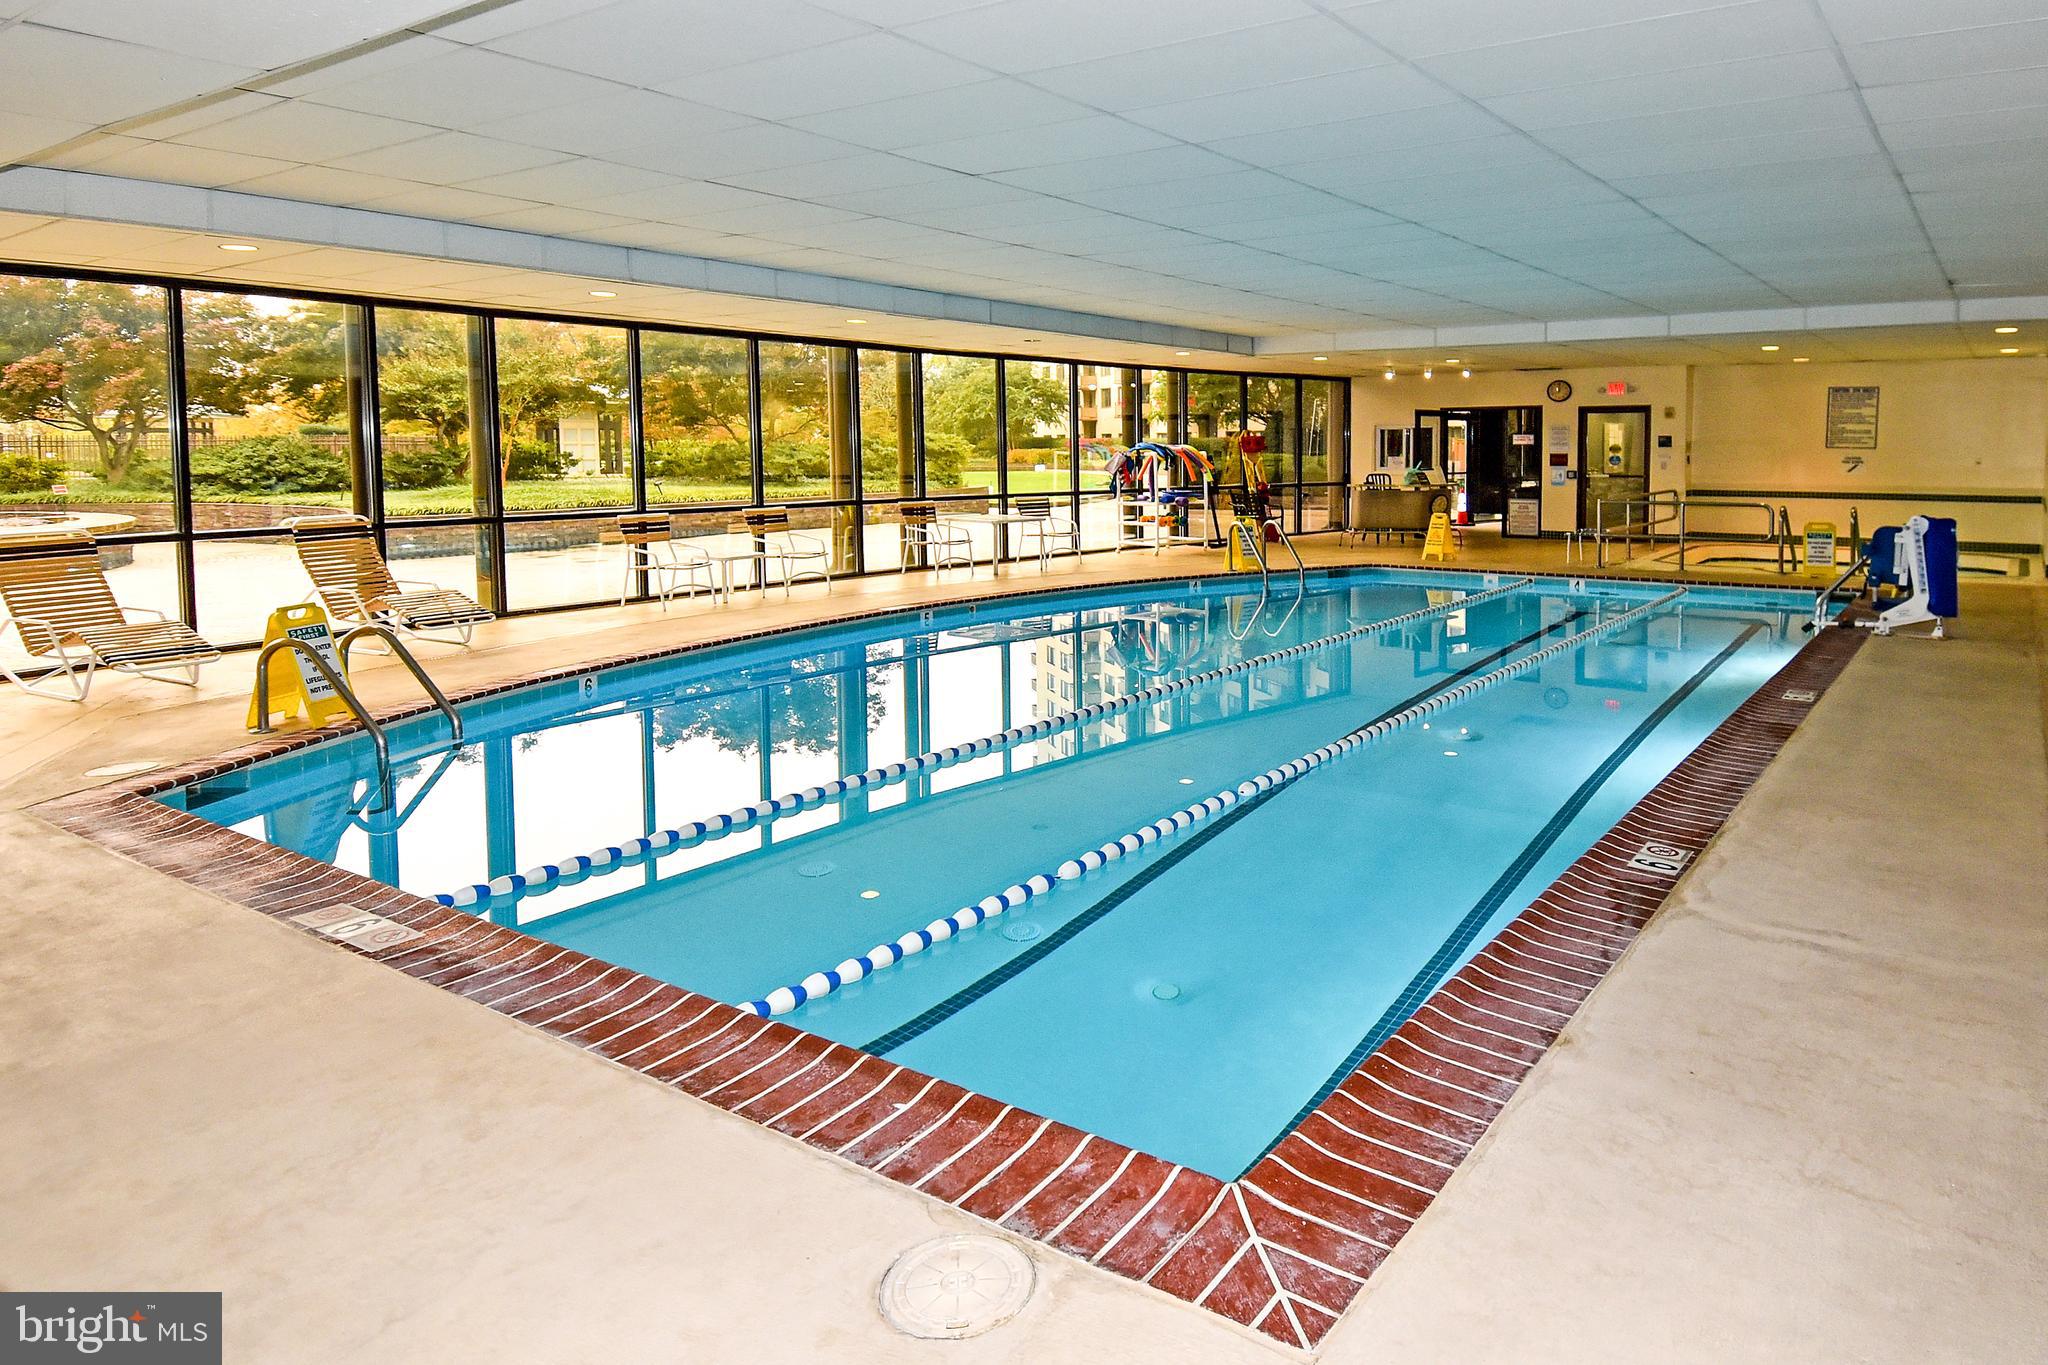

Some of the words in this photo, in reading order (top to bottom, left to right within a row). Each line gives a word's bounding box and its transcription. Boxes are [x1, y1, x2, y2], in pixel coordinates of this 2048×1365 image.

[290, 625, 324, 638] SAFETY
[298, 632, 320, 640] FIRST
[315, 643, 332, 651] ENTER
[584, 677, 593, 691] 6
[1634, 858, 1679, 871] 6
[331, 918, 383, 935] 6
